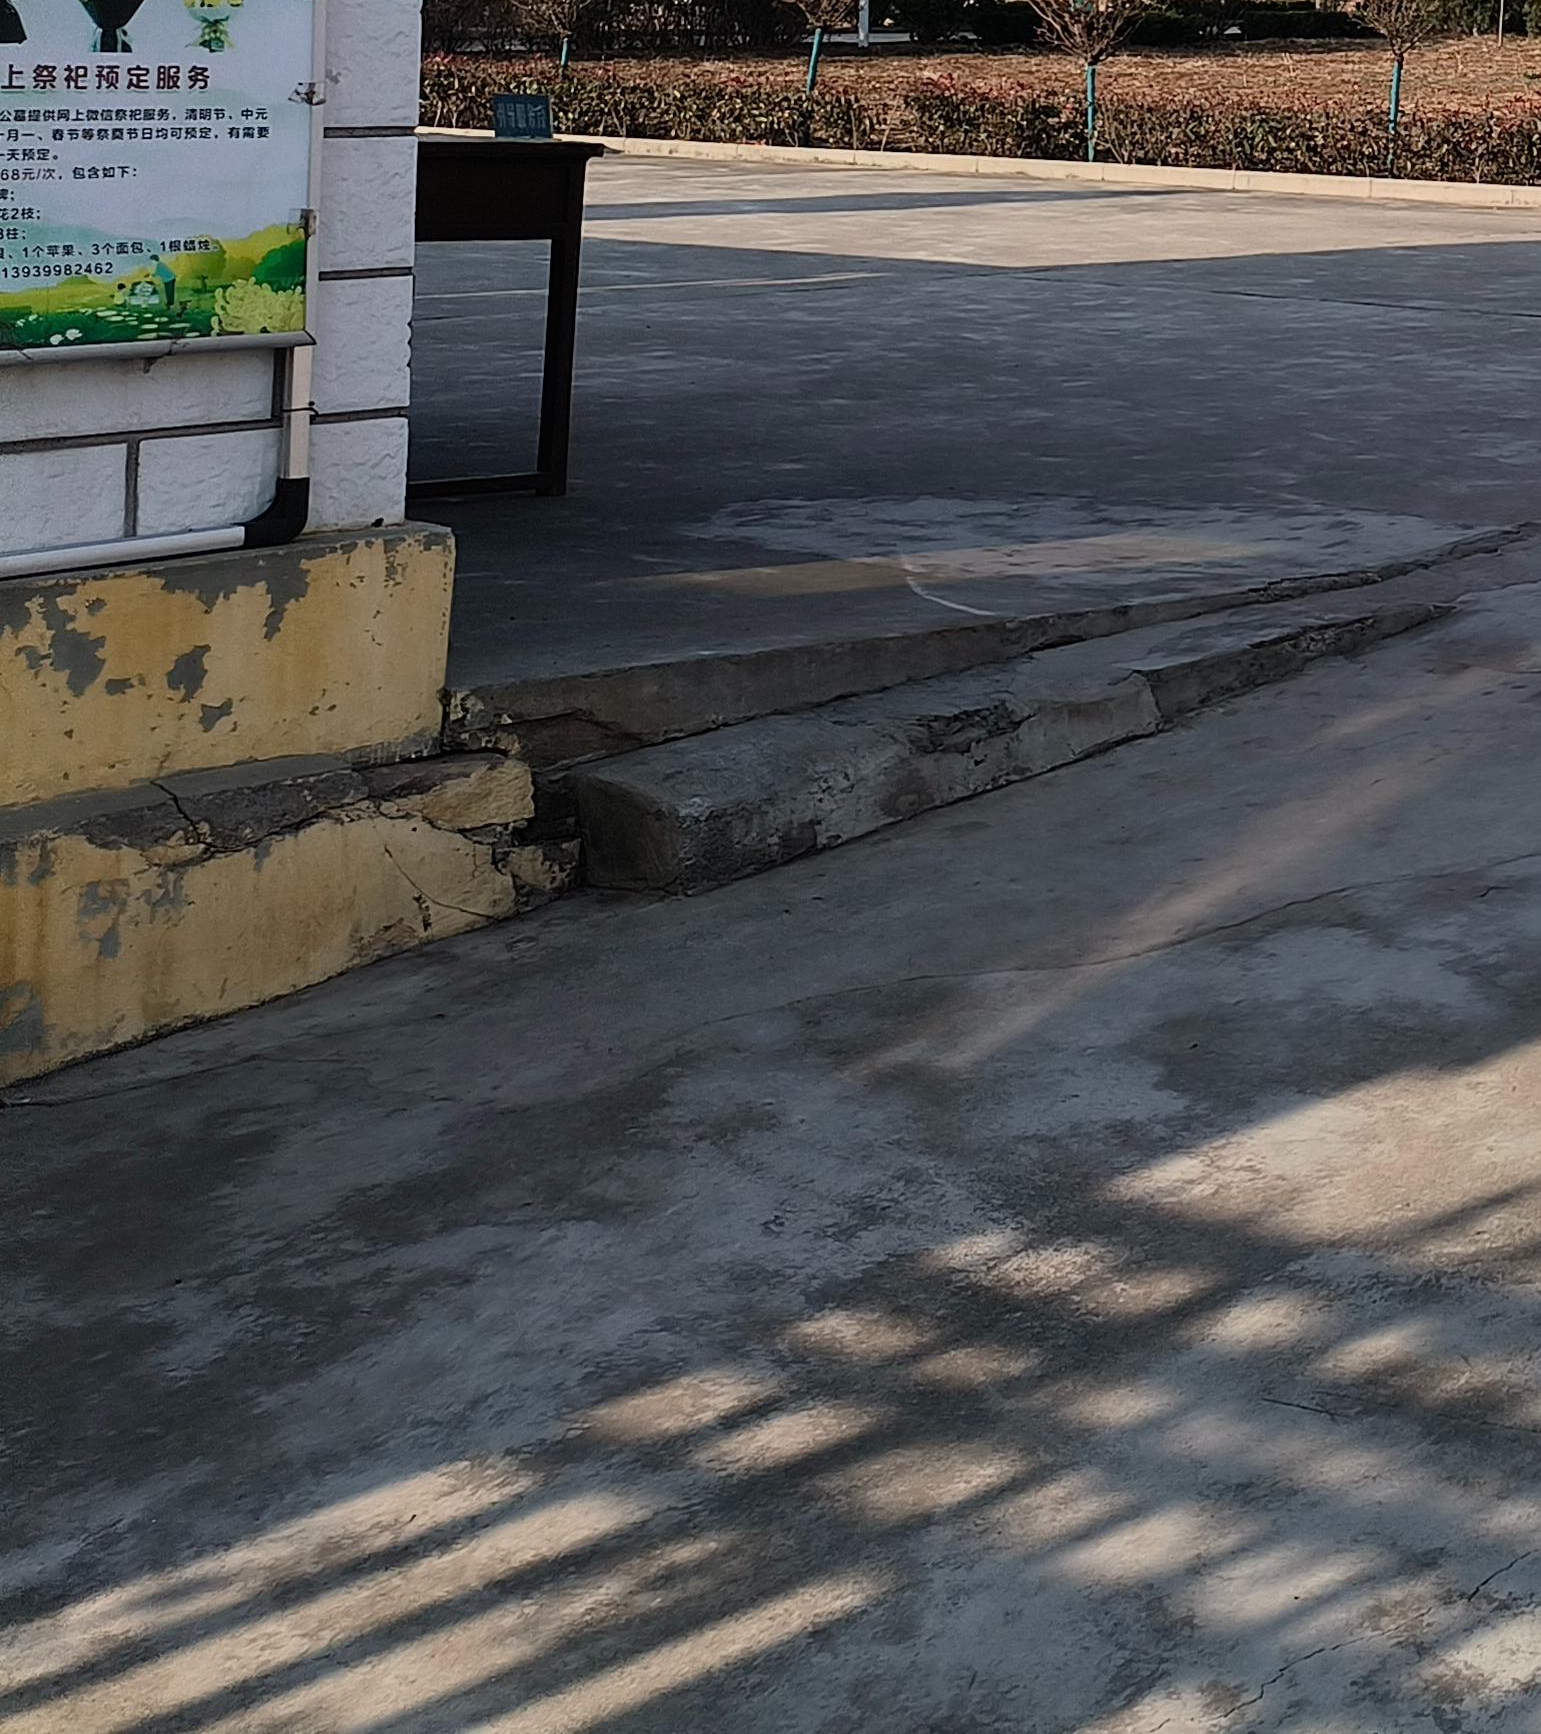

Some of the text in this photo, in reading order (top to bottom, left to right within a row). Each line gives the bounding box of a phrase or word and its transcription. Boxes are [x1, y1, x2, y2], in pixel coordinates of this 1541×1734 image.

[1, 64, 210, 91] 上祭祀预定服务
